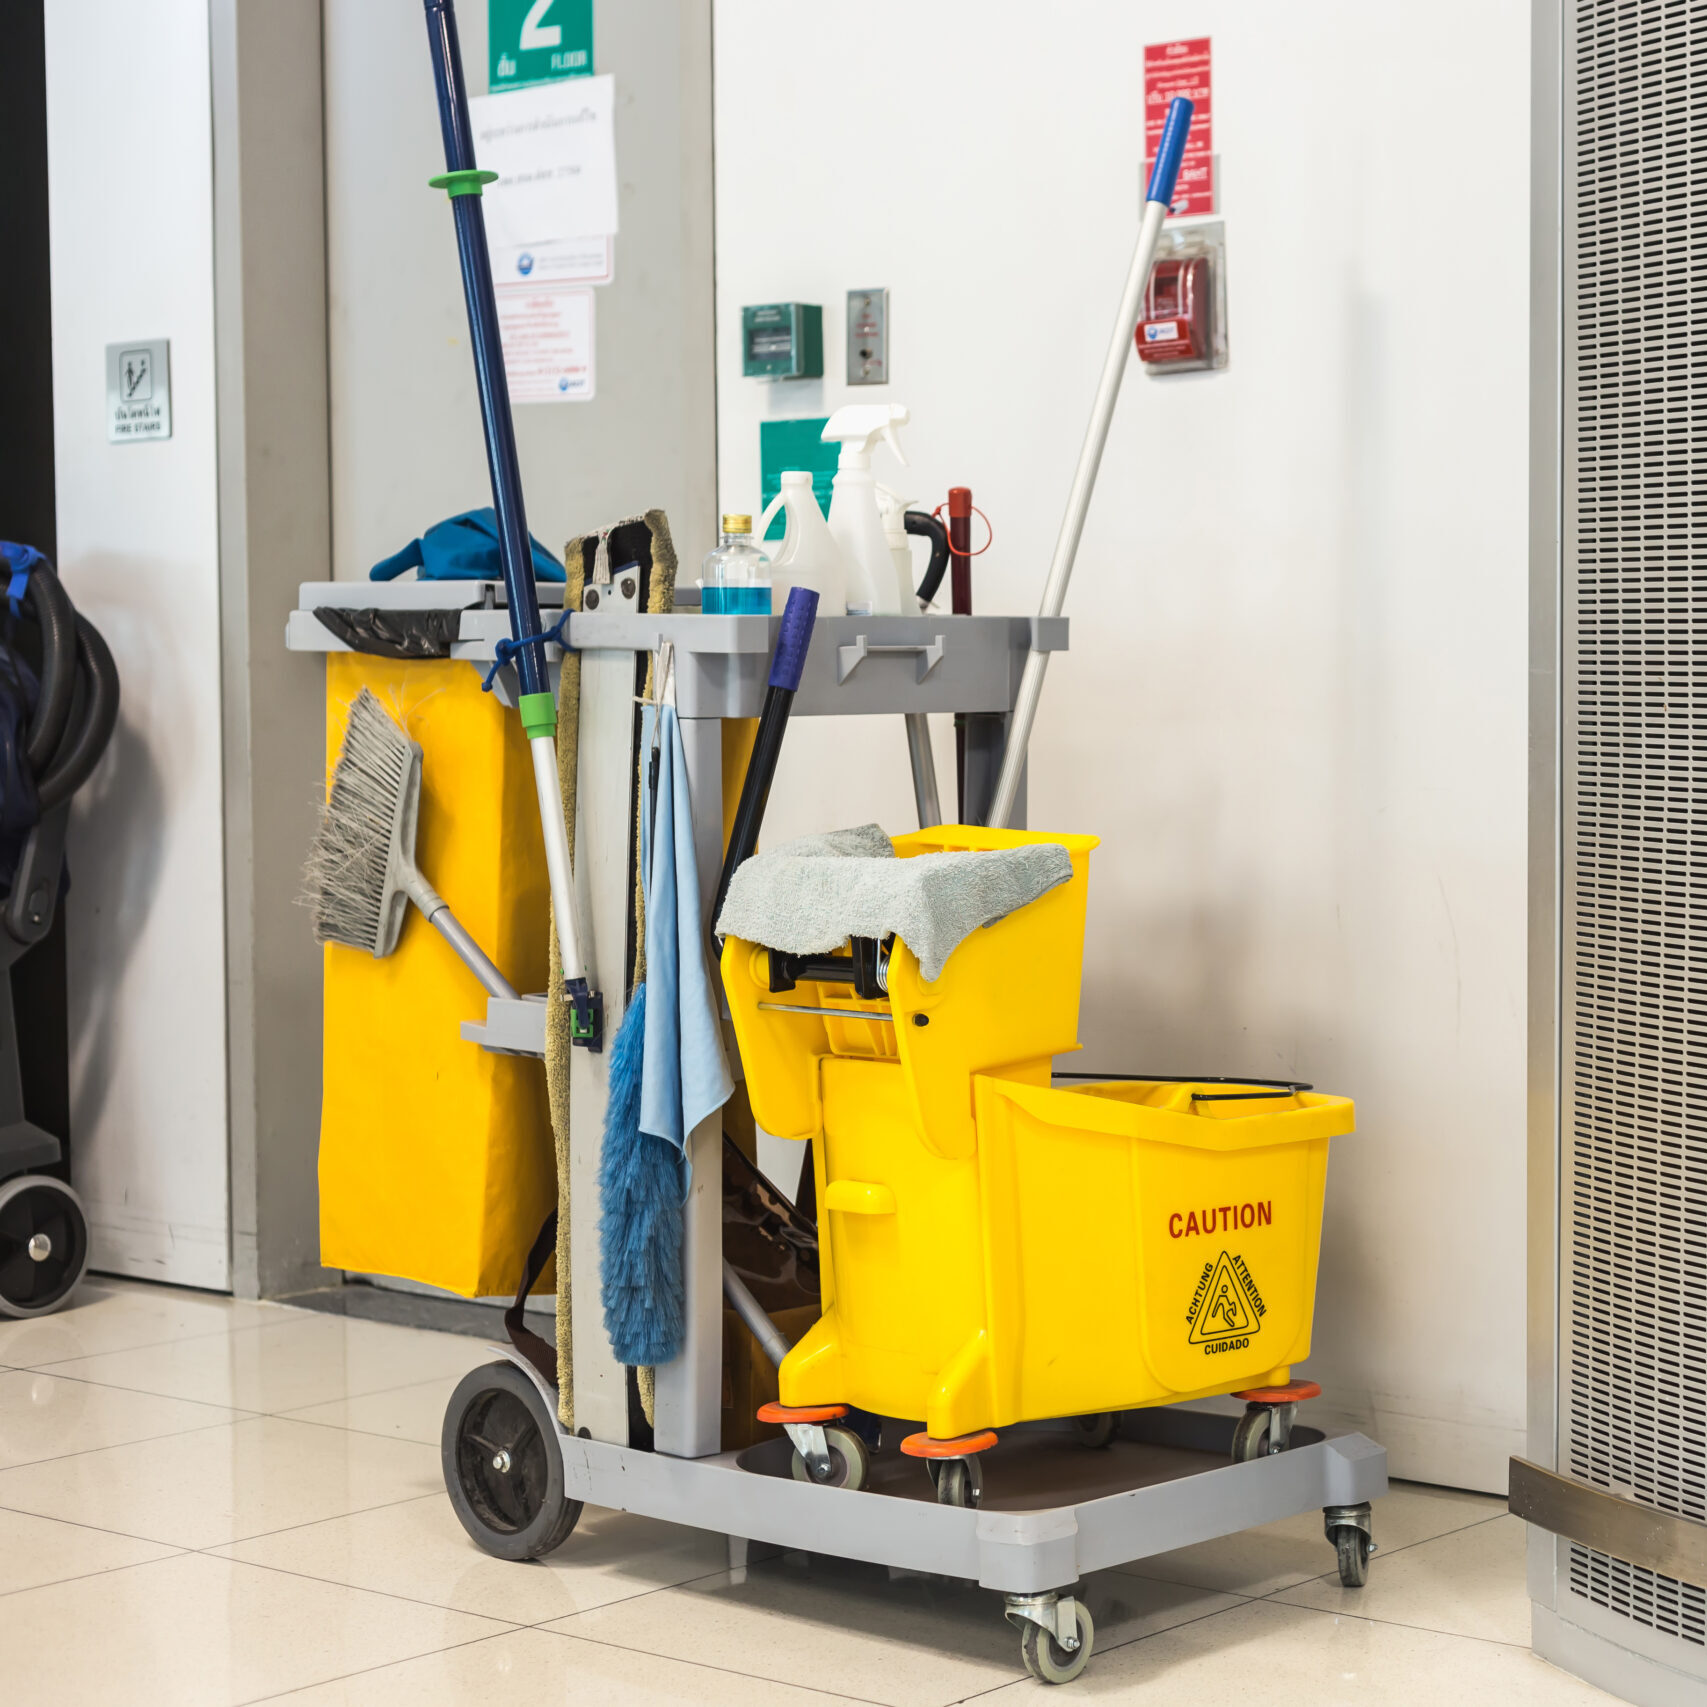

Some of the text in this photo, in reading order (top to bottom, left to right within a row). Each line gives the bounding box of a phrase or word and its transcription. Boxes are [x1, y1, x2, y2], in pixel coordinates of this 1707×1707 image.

[519, 0, 562, 51] 2
[551, 50, 588, 70] FLOOR
[115, 421, 161, 434] FIRE STAIRS
[1168, 1200, 1272, 1239] CAUTION
[1185, 1262, 1214, 1325] ACHTUNG
[1232, 1254, 1267, 1317] ATTENTION
[1204, 1337, 1250, 1356] CUIDADO
